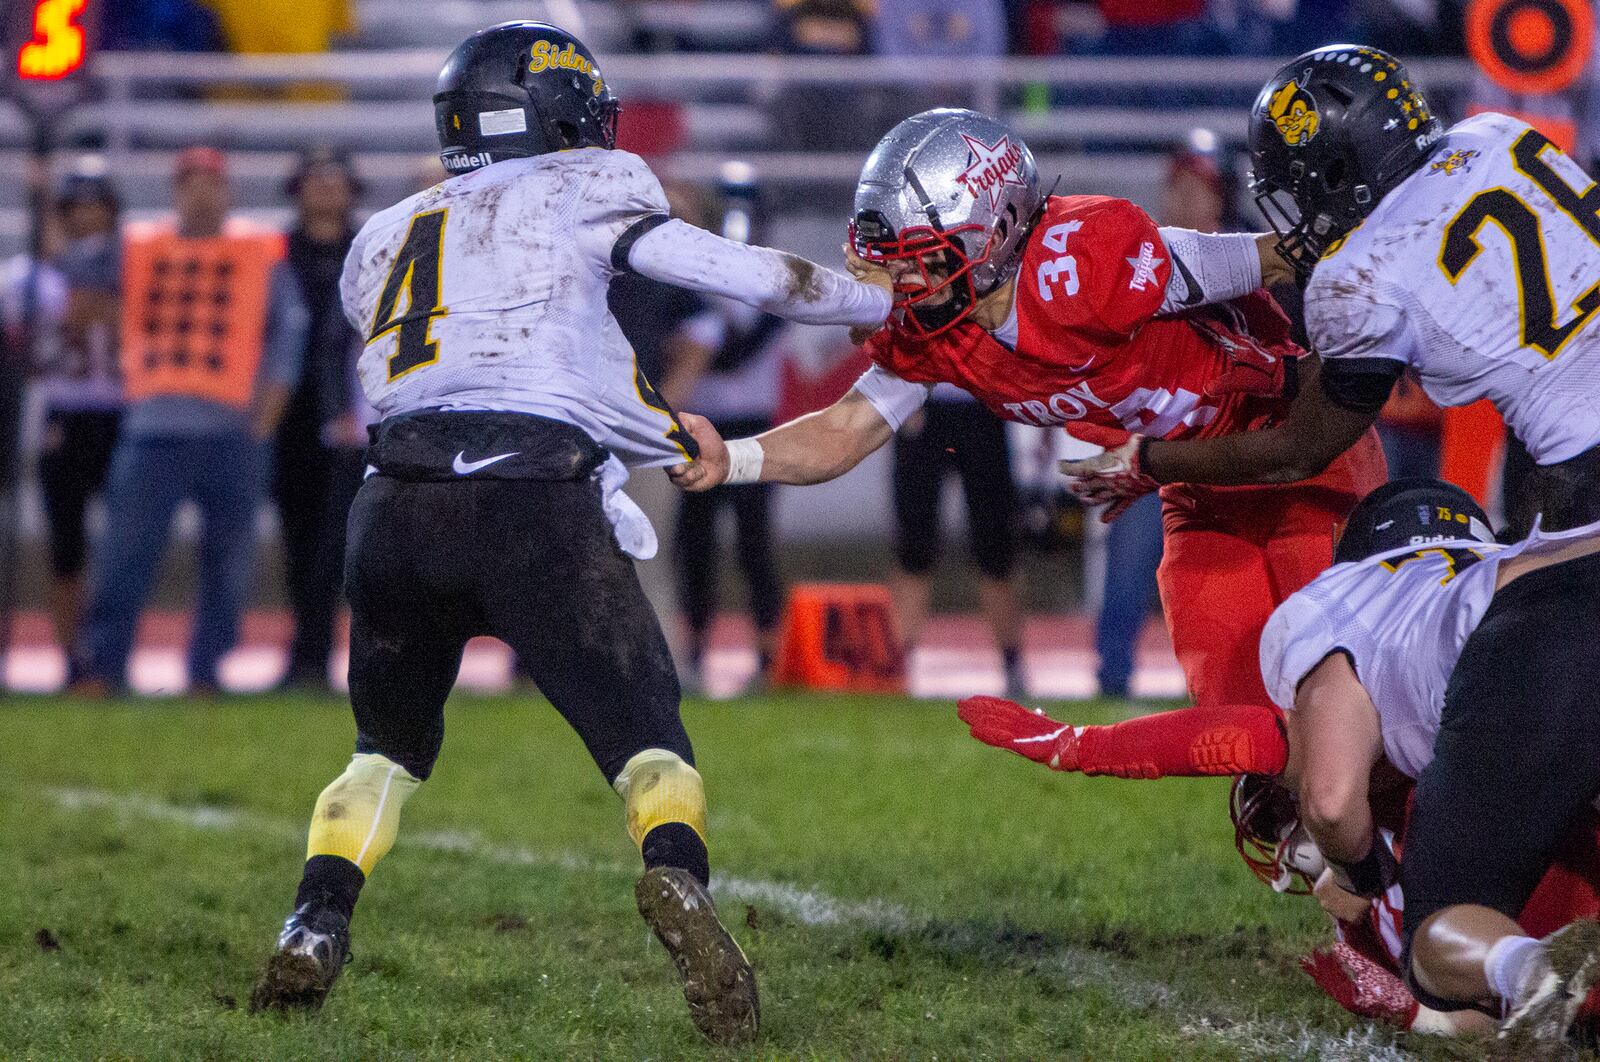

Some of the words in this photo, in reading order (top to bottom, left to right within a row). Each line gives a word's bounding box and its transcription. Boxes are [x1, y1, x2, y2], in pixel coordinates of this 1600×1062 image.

[442, 152, 493, 170] Riddell
[955, 143, 1021, 199] Trojans
[1037, 219, 1084, 302] 34
[1129, 241, 1155, 292] Trojans
[366, 208, 449, 384] 4
[1002, 381, 1110, 427] TROY
[1436, 507, 1452, 521] 75
